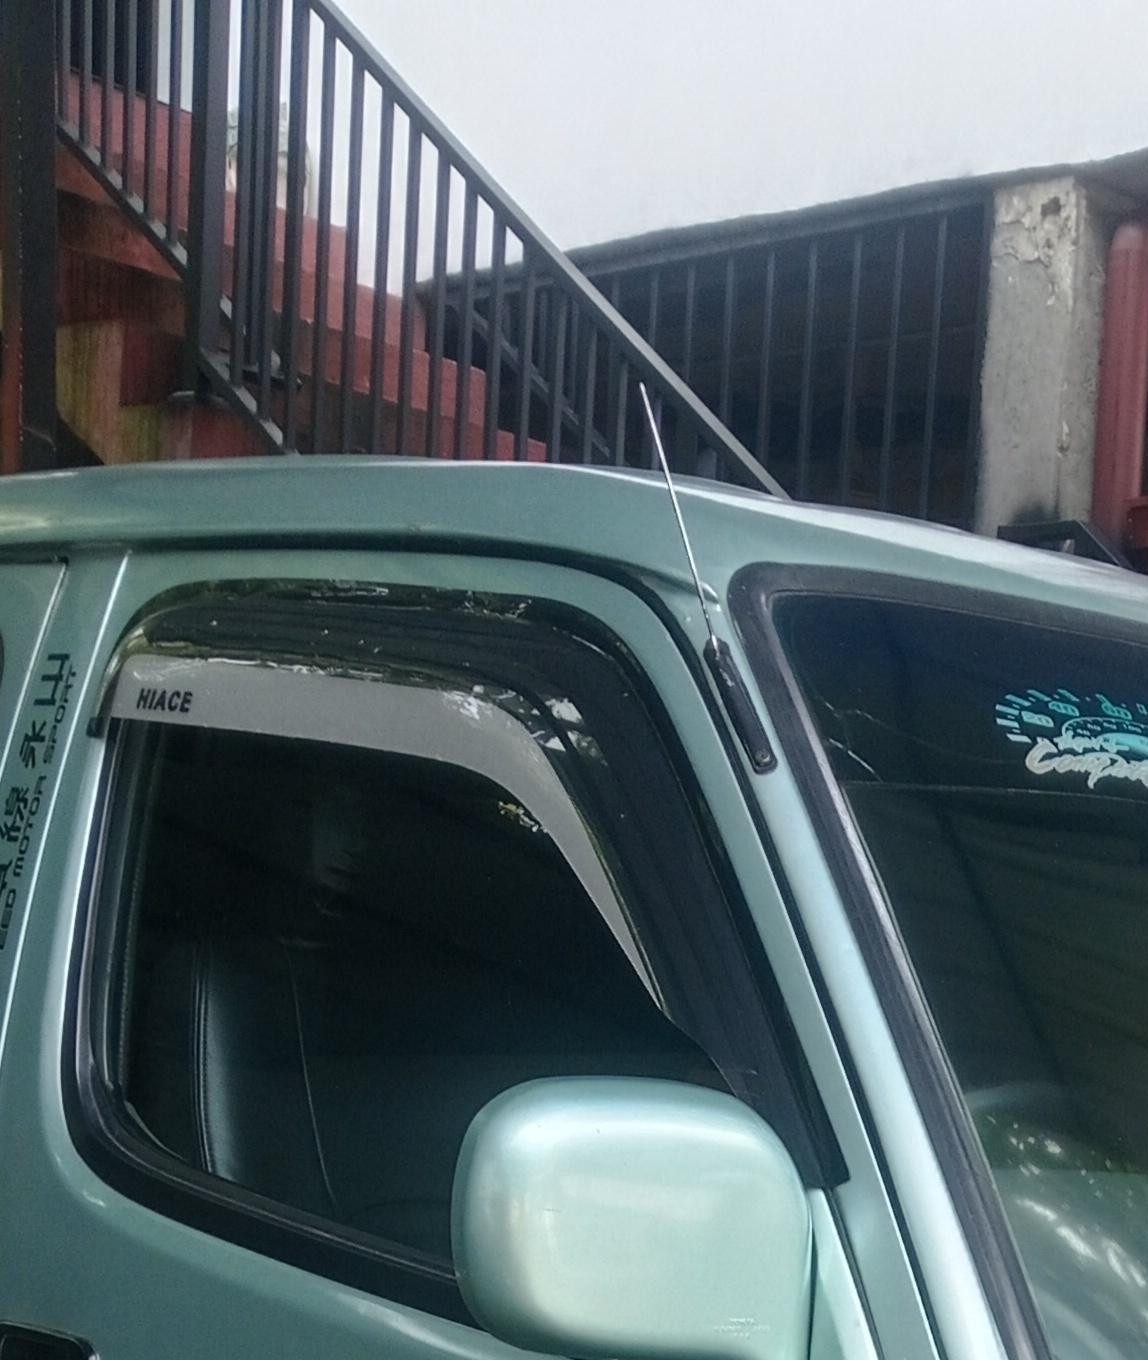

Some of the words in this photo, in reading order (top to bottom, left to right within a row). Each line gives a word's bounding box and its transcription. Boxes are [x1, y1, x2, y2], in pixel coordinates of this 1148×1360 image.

[136, 687, 193, 713] HIACE
[13, 775, 53, 878] MOTOR
[42, 663, 77, 764] SPORT
